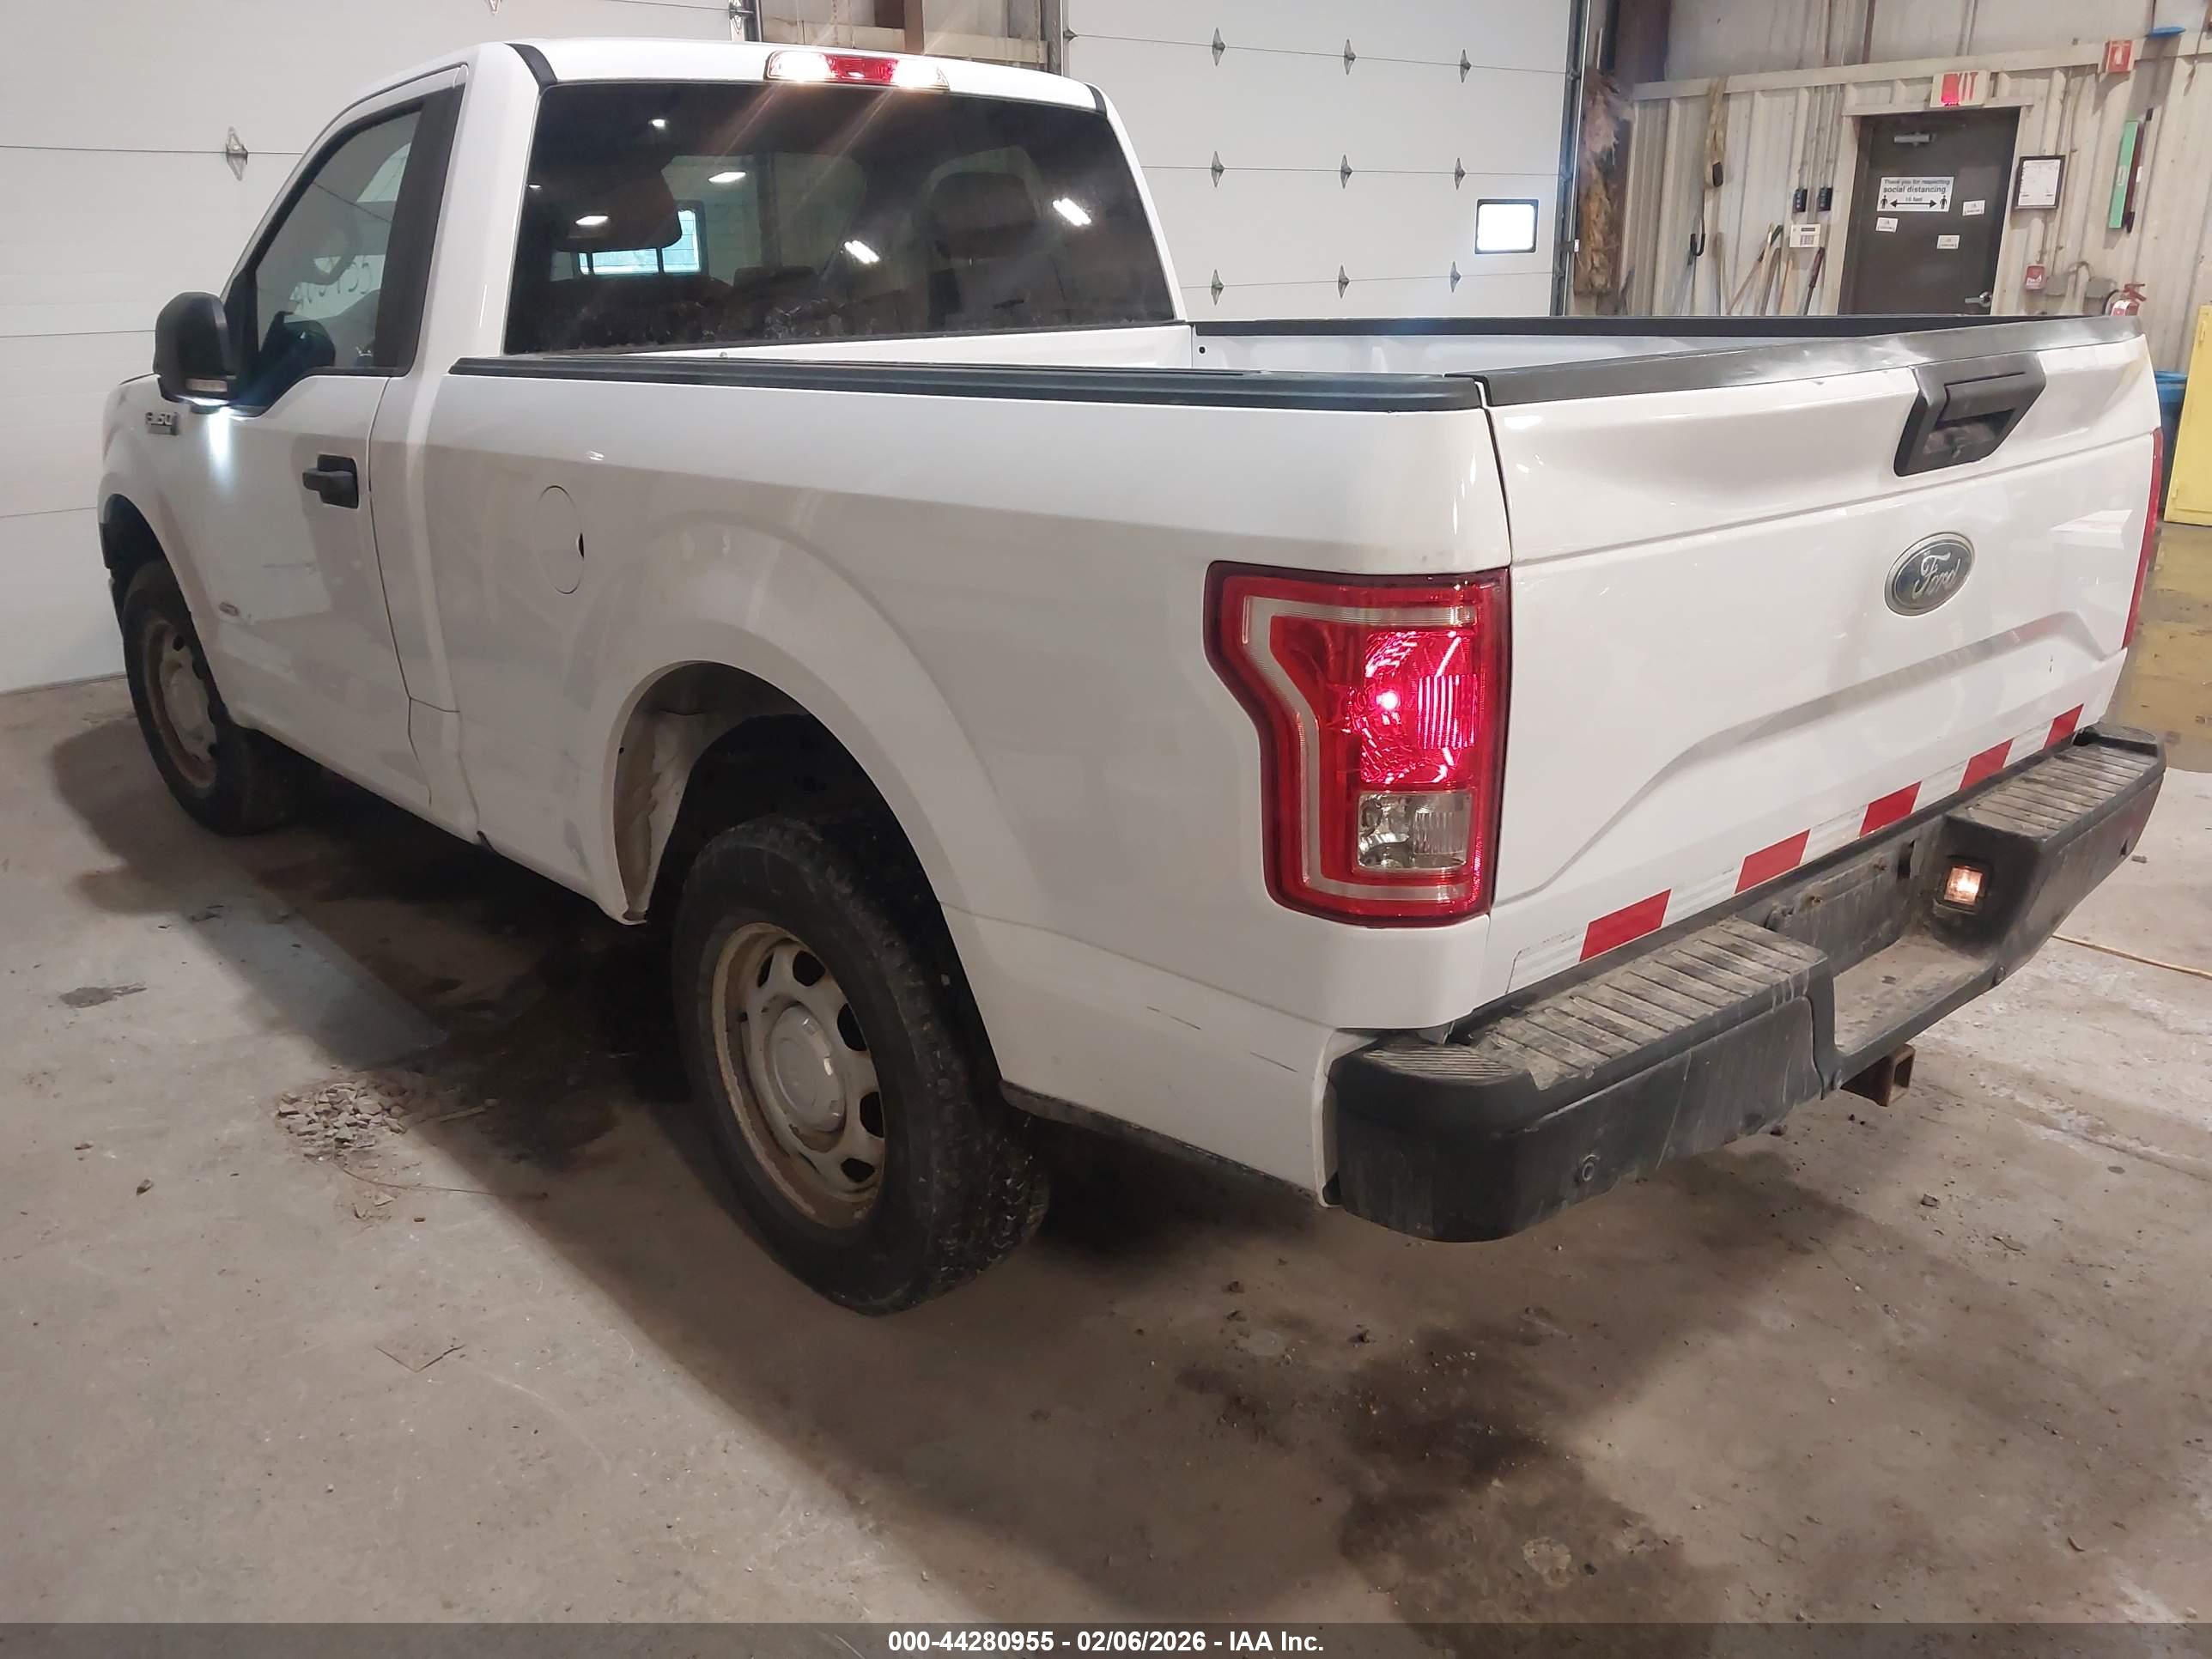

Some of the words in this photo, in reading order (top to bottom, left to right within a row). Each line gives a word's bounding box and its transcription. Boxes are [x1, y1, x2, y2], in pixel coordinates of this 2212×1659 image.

[1941, 71, 1978, 101] XIT
[1906, 185, 1947, 194] distancing
[1911, 551, 1961, 601] Ford
